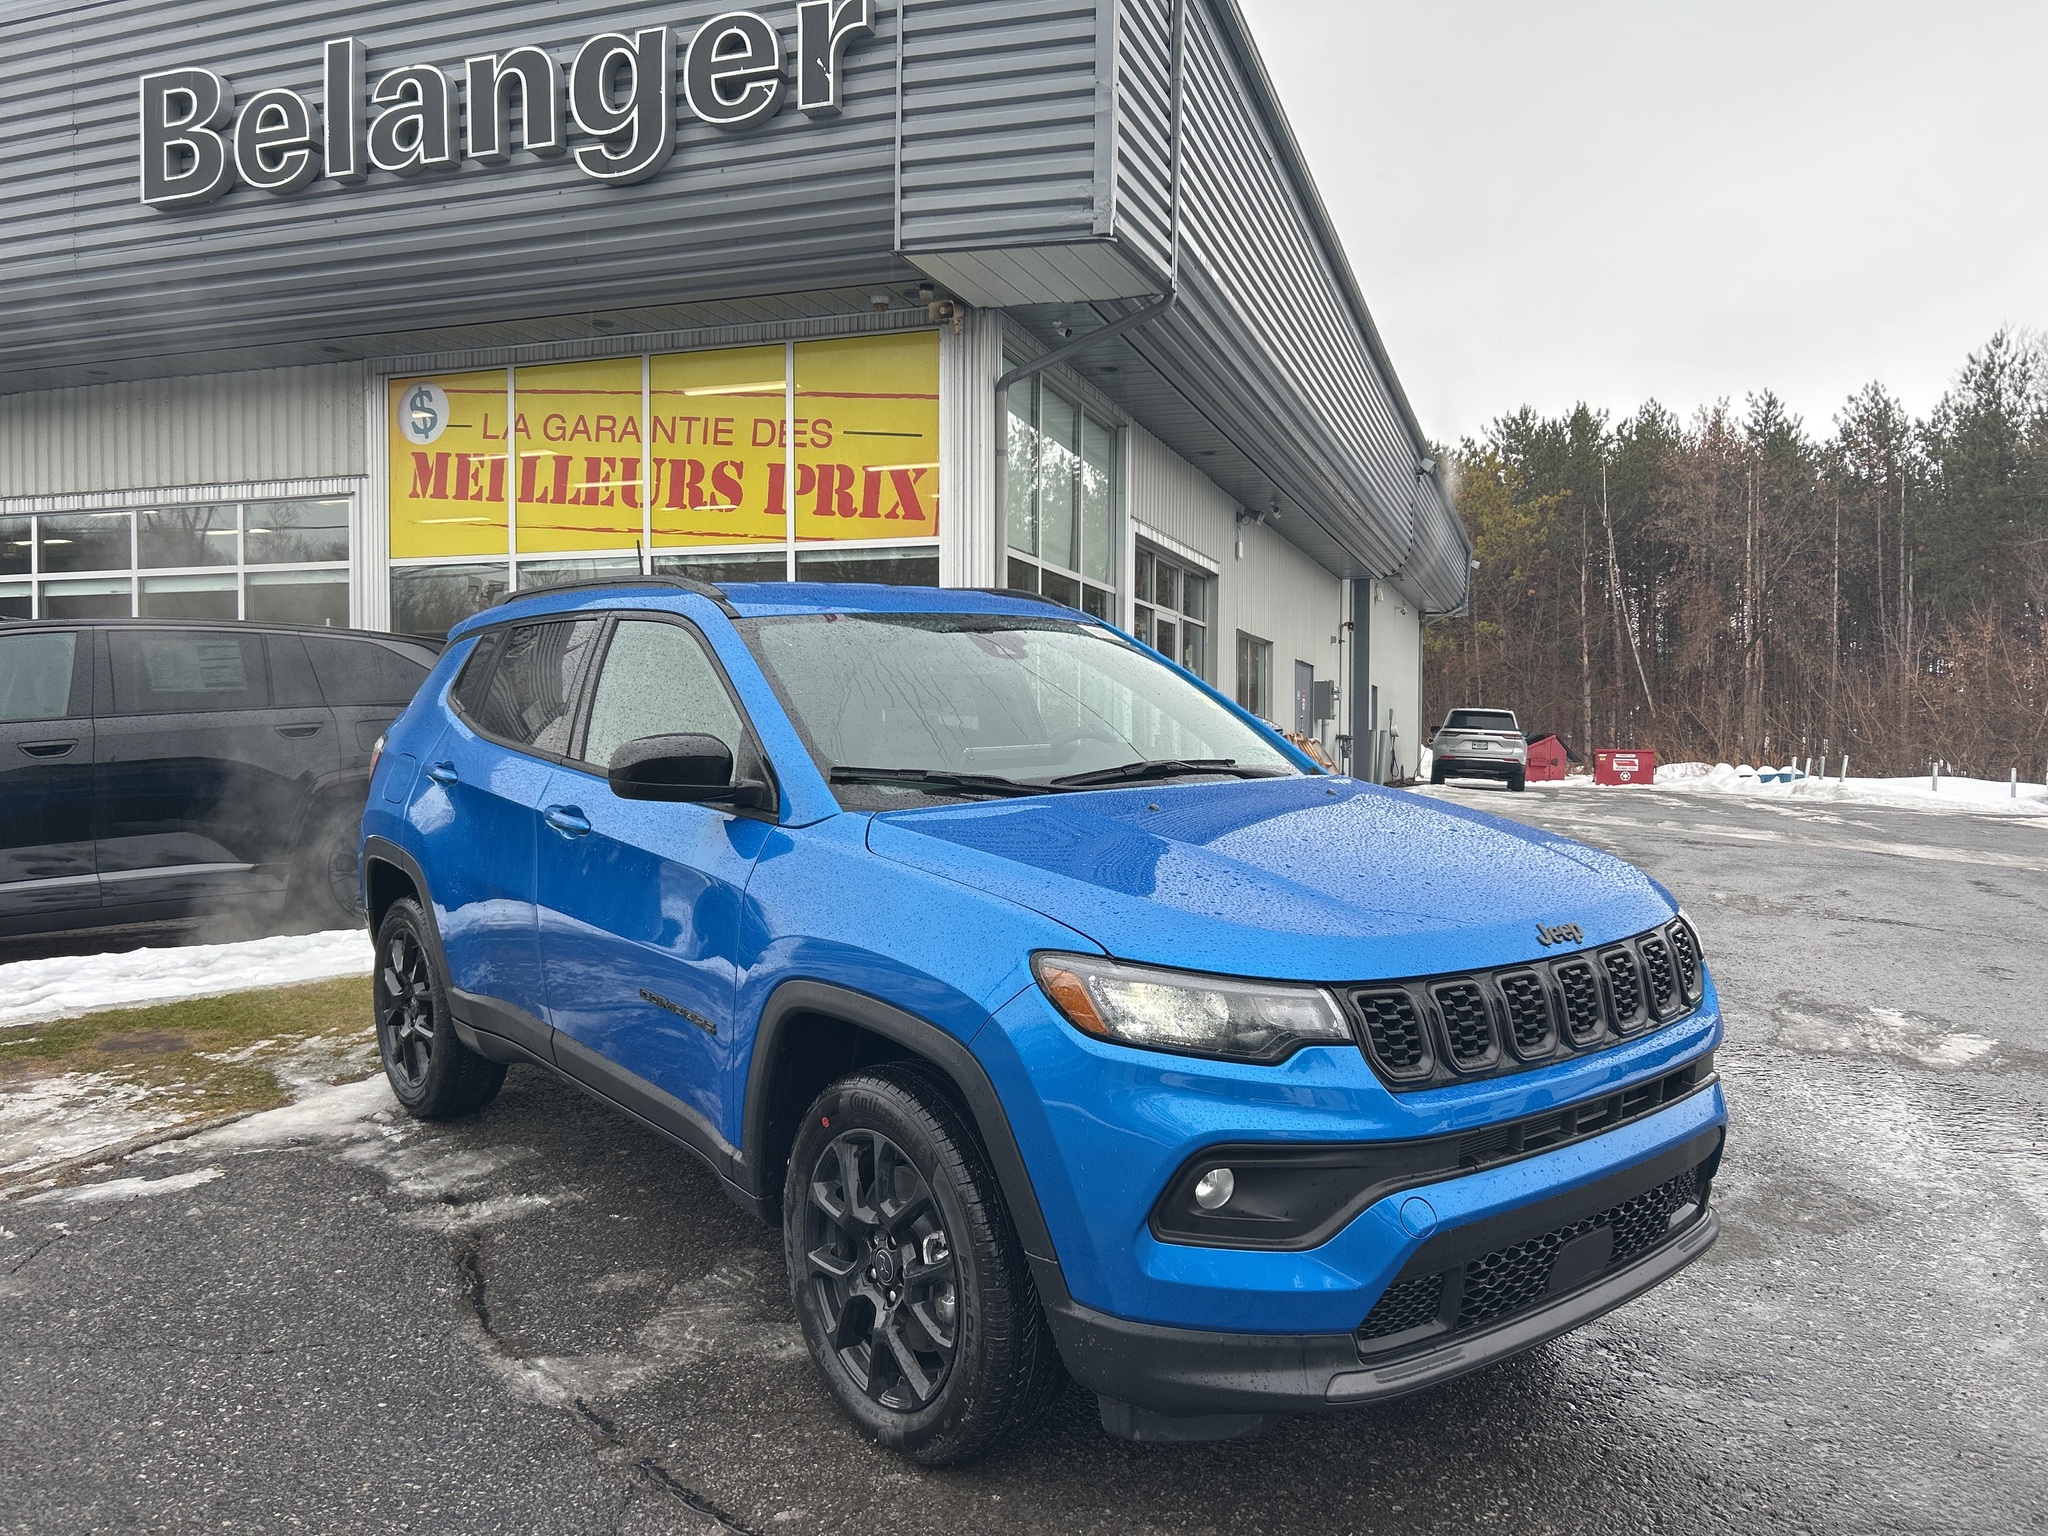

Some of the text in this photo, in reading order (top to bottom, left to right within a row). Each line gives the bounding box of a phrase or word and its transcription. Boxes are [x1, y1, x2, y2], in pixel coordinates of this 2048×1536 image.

[139, 0, 874, 207] Belanger
[482, 412, 833, 448] LA GARANTIE DES
[408, 451, 928, 521] MEILLEURS PRIX
[1536, 922, 1583, 946] Jeep
